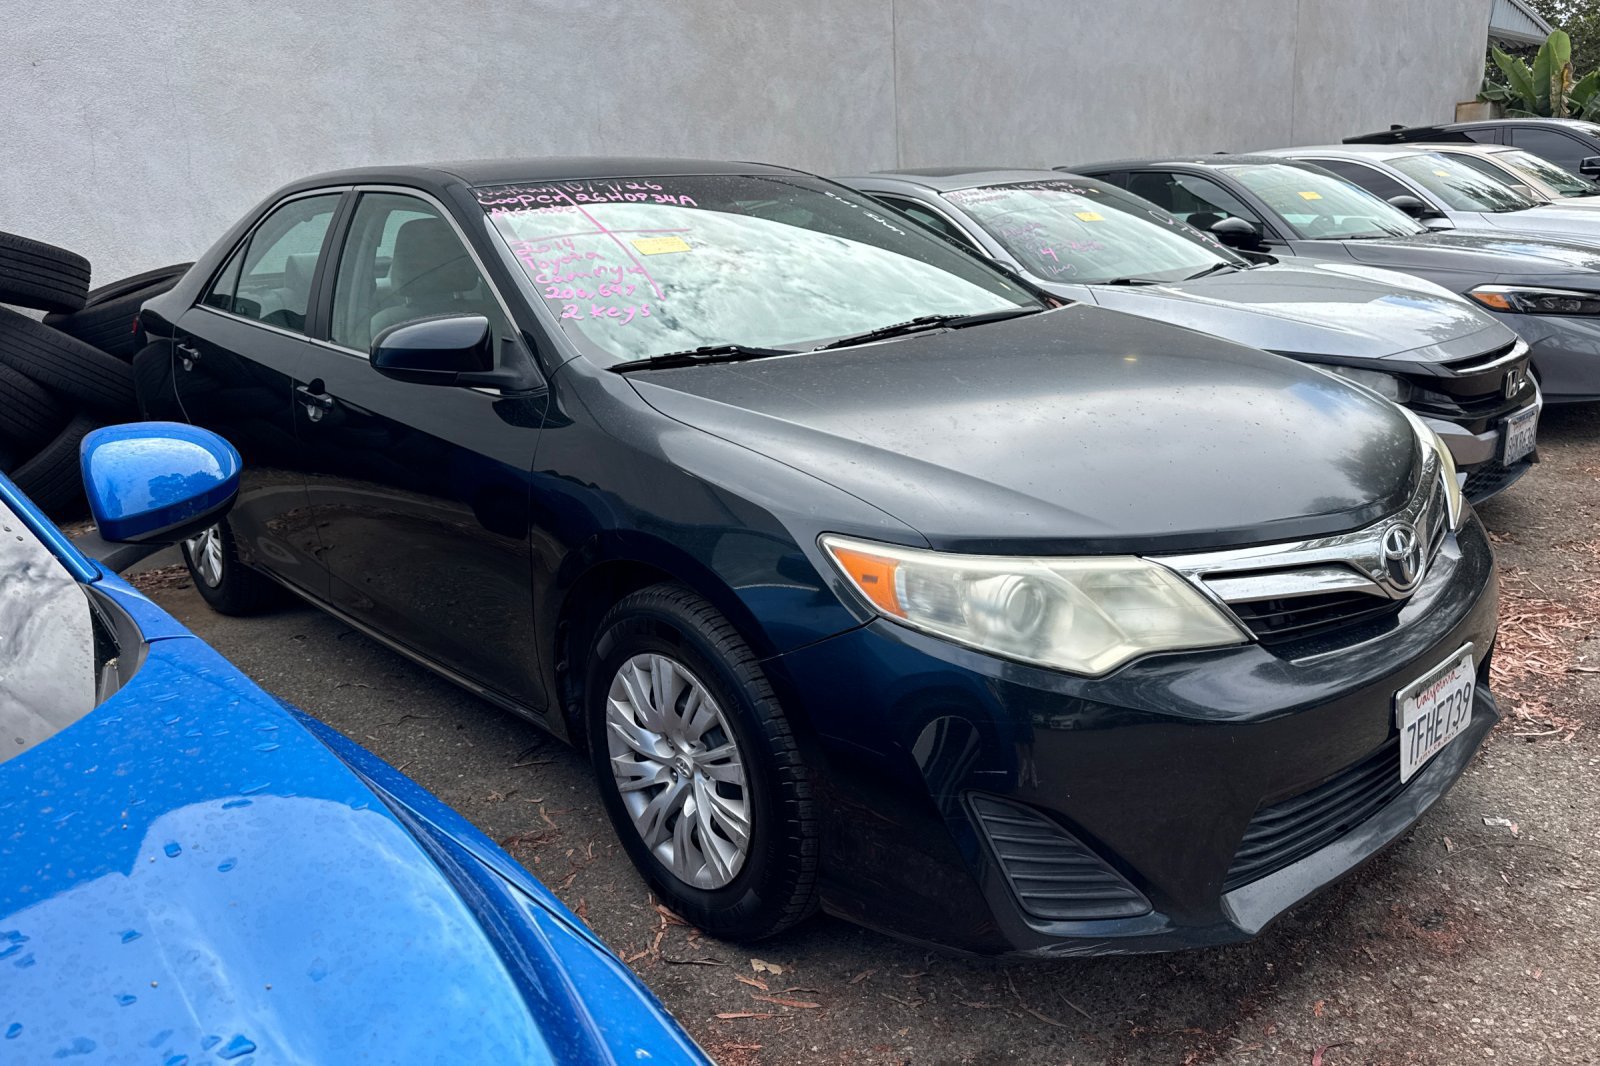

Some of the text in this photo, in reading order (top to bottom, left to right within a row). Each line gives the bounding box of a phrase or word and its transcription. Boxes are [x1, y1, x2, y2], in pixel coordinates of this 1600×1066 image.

[513, 238, 575, 256] 2014
[521, 252, 606, 275] Toyota
[561, 304, 584, 320] 2
[1416, 669, 1462, 710] California
[1407, 681, 1472, 766] 7FHE739
